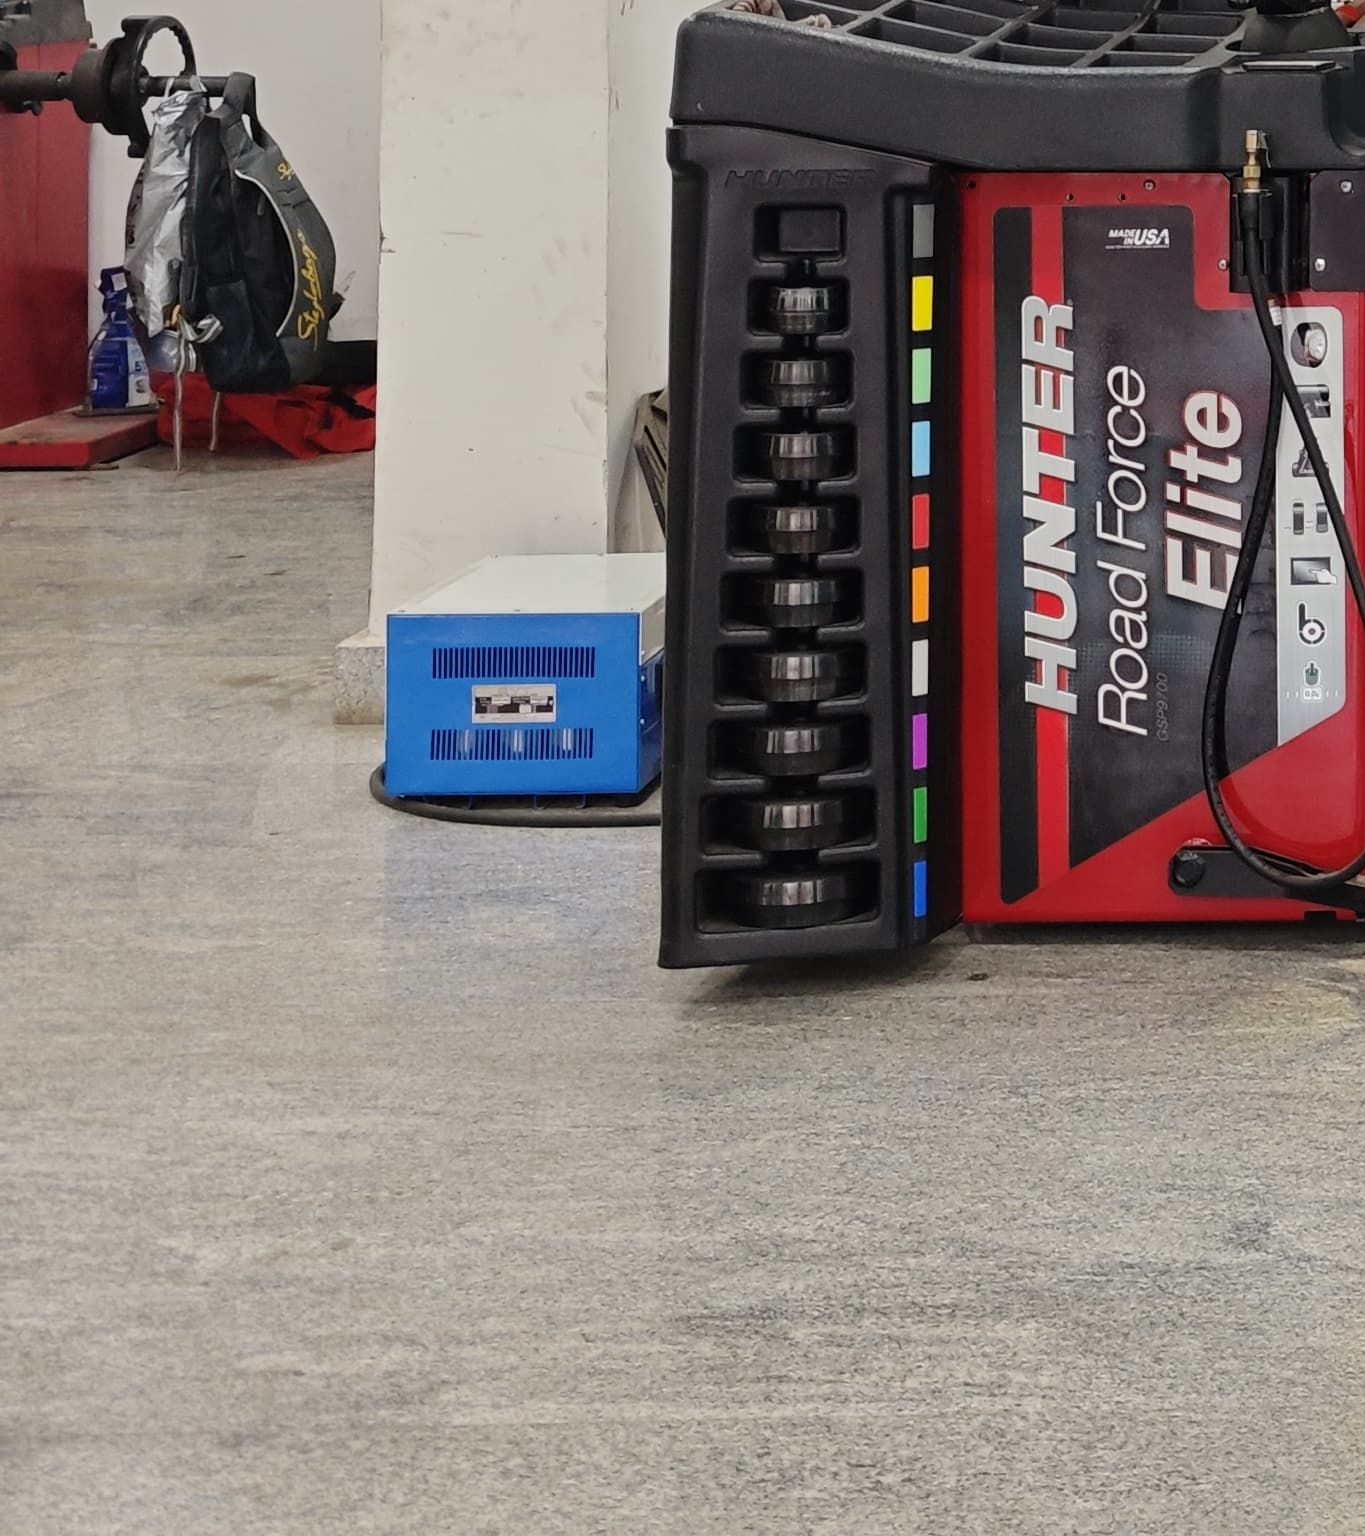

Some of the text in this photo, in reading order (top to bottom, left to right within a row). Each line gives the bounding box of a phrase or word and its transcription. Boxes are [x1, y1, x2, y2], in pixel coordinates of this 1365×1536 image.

[1108, 229, 1136, 238] MADE
[1134, 228, 1170, 246] USA
[1021, 295, 1078, 715] HUNTER
[1097, 365, 1149, 736] Road Force
[1165, 390, 1242, 613] Elite
[1156, 672, 1168, 742] GSP9700
